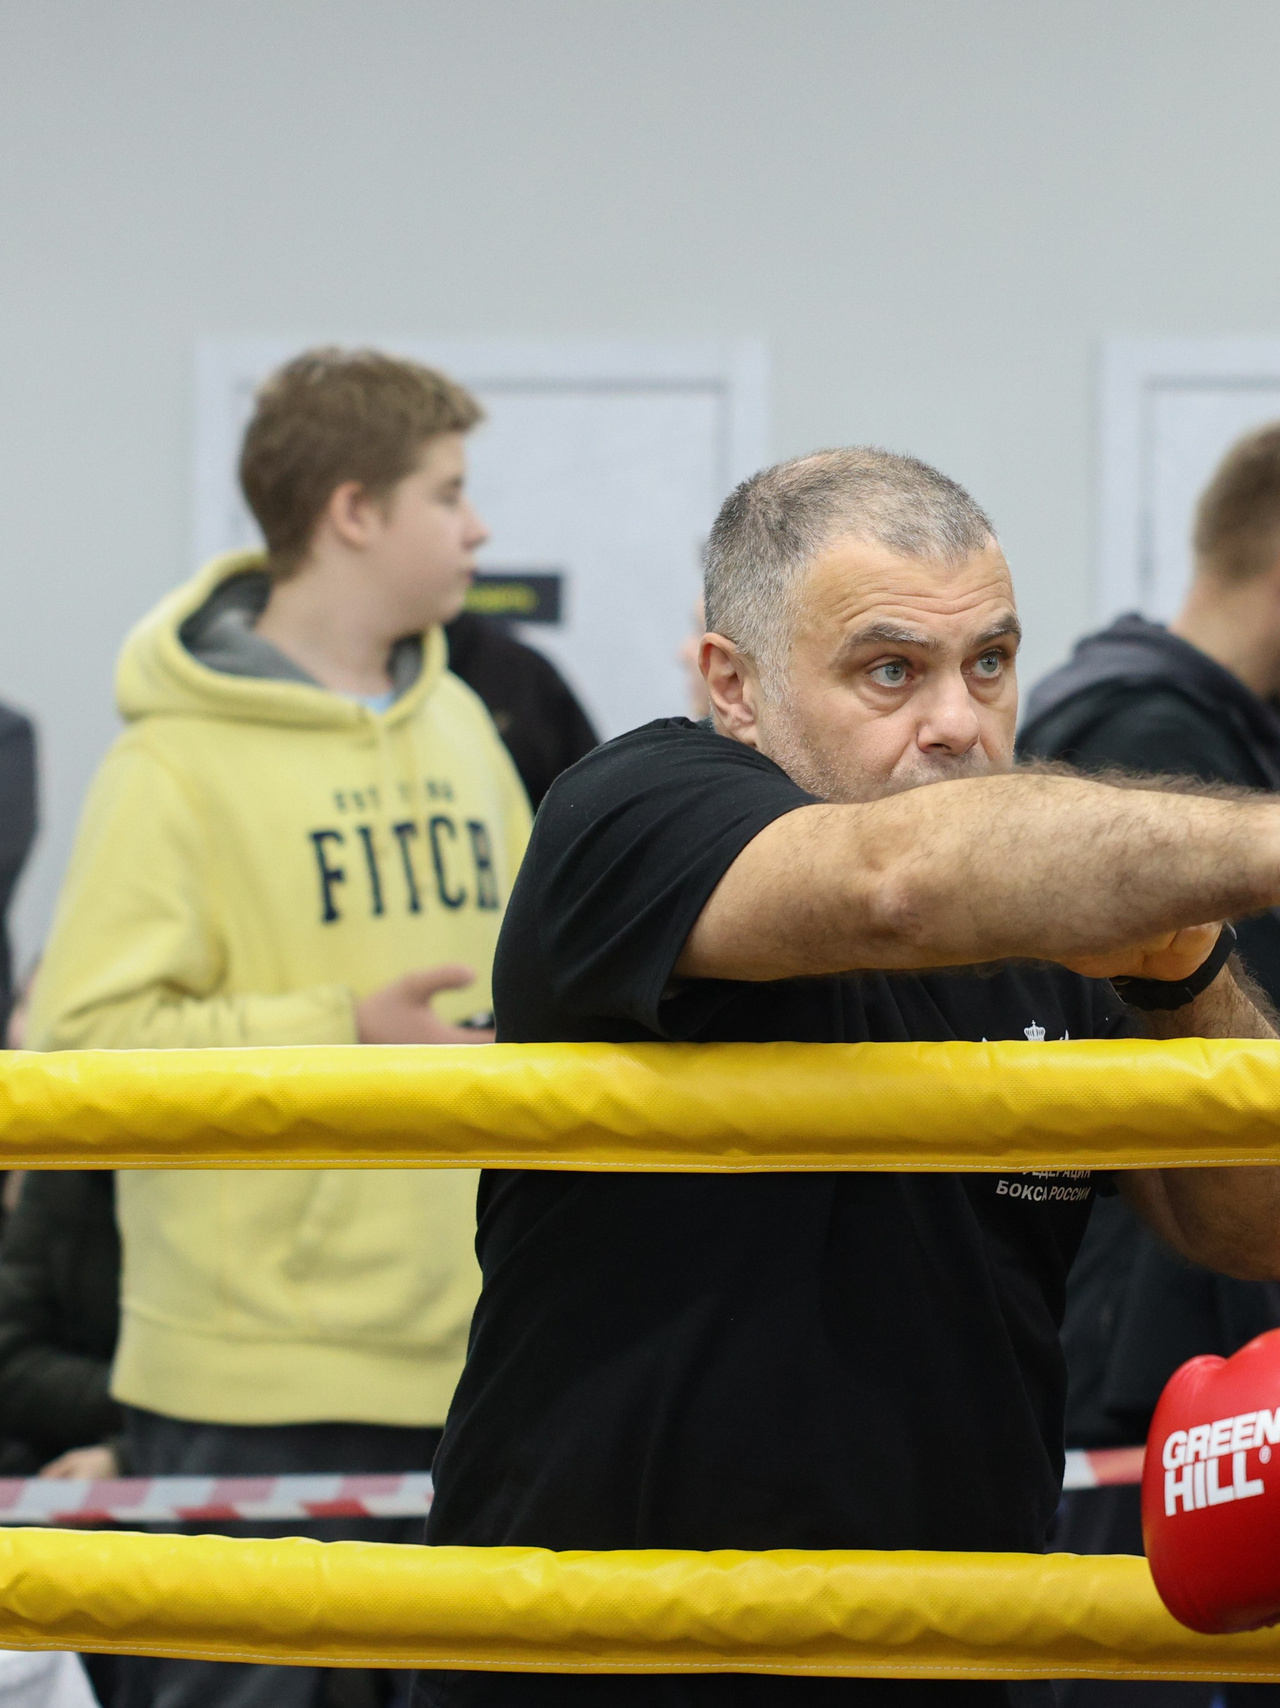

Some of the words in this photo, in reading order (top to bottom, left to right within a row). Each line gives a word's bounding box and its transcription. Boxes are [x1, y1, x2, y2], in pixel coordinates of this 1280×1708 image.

[309, 814, 499, 925] FITCH
[996, 1179, 1048, 1202] БОКСА
[1048, 1186, 1092, 1202] РОССИИ
[1164, 1450, 1265, 1517] HILL
